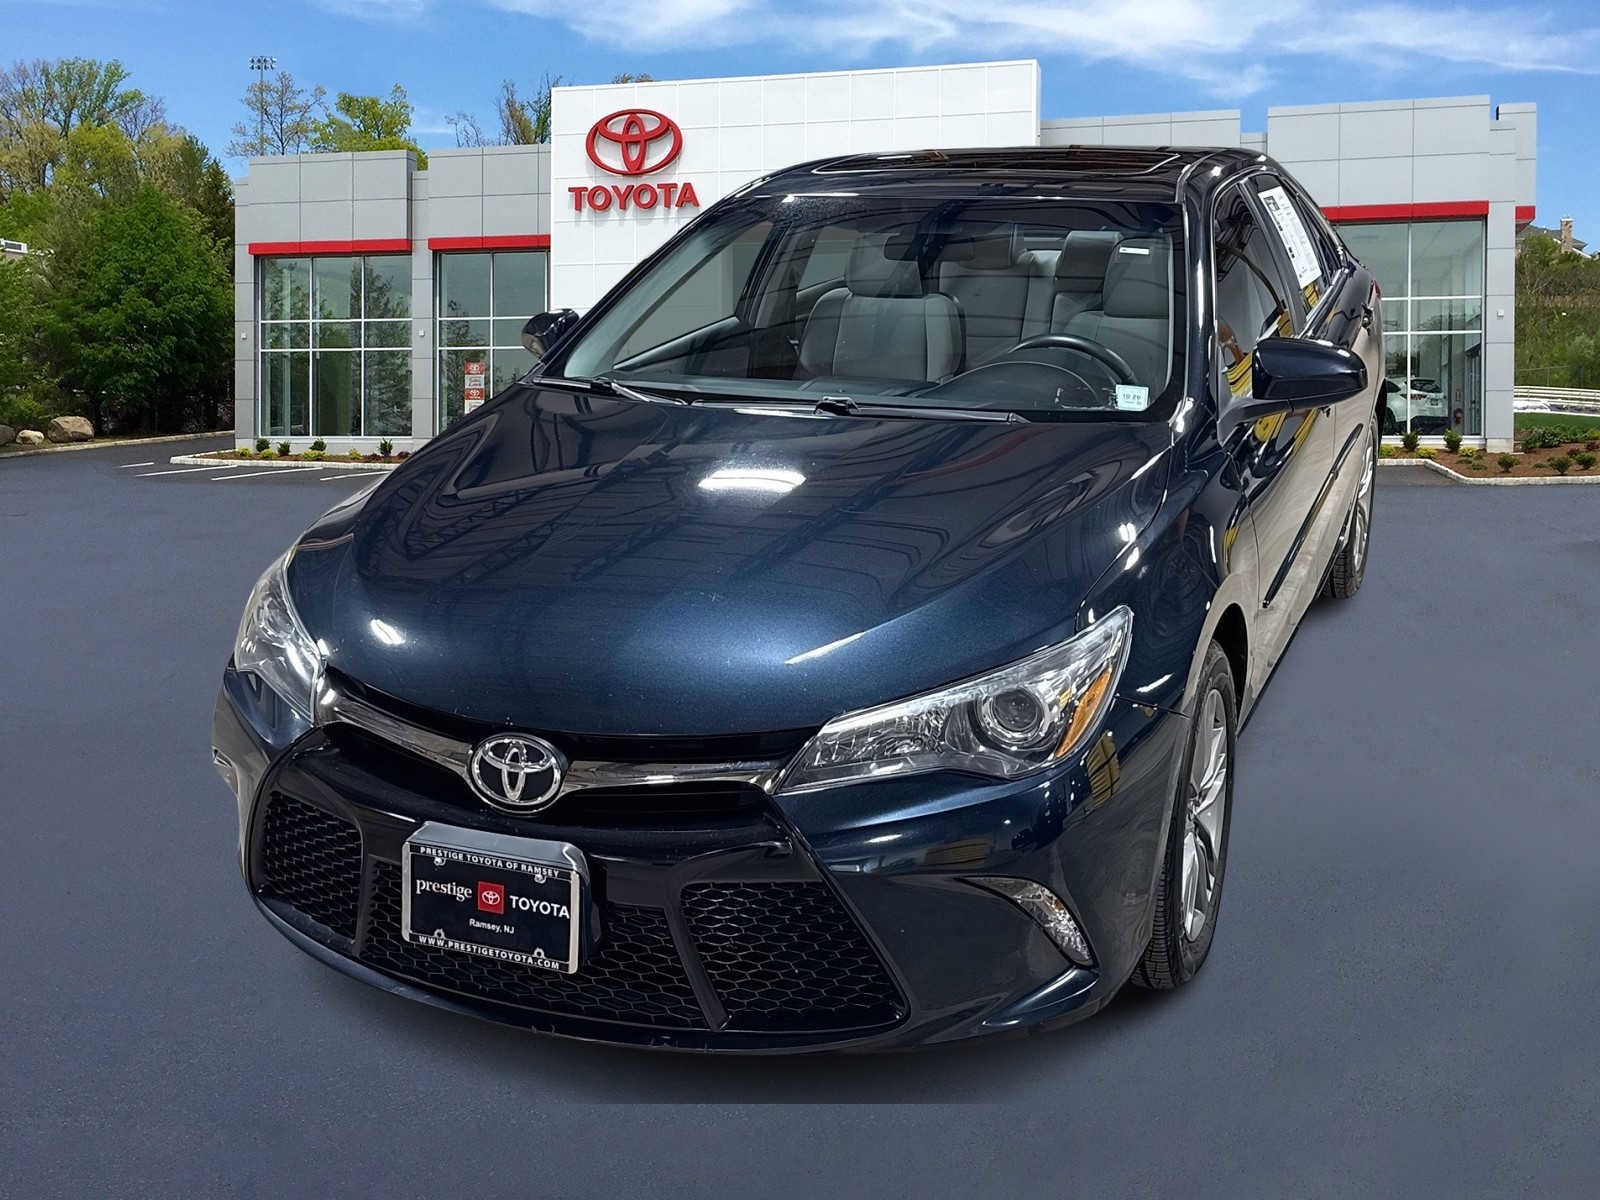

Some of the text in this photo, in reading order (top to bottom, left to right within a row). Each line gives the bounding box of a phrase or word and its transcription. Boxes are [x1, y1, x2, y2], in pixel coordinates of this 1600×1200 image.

[568, 182, 700, 212] TOYOTA
[420, 846, 560, 878] PRESTIGE TOYOTA OF RAMSEY
[416, 879, 570, 919] prestige TOYOTA
[469, 918, 515, 935] Ramsey, NJ
[418, 935, 560, 970] WWW.PRESTIGETOYOTA.COM
